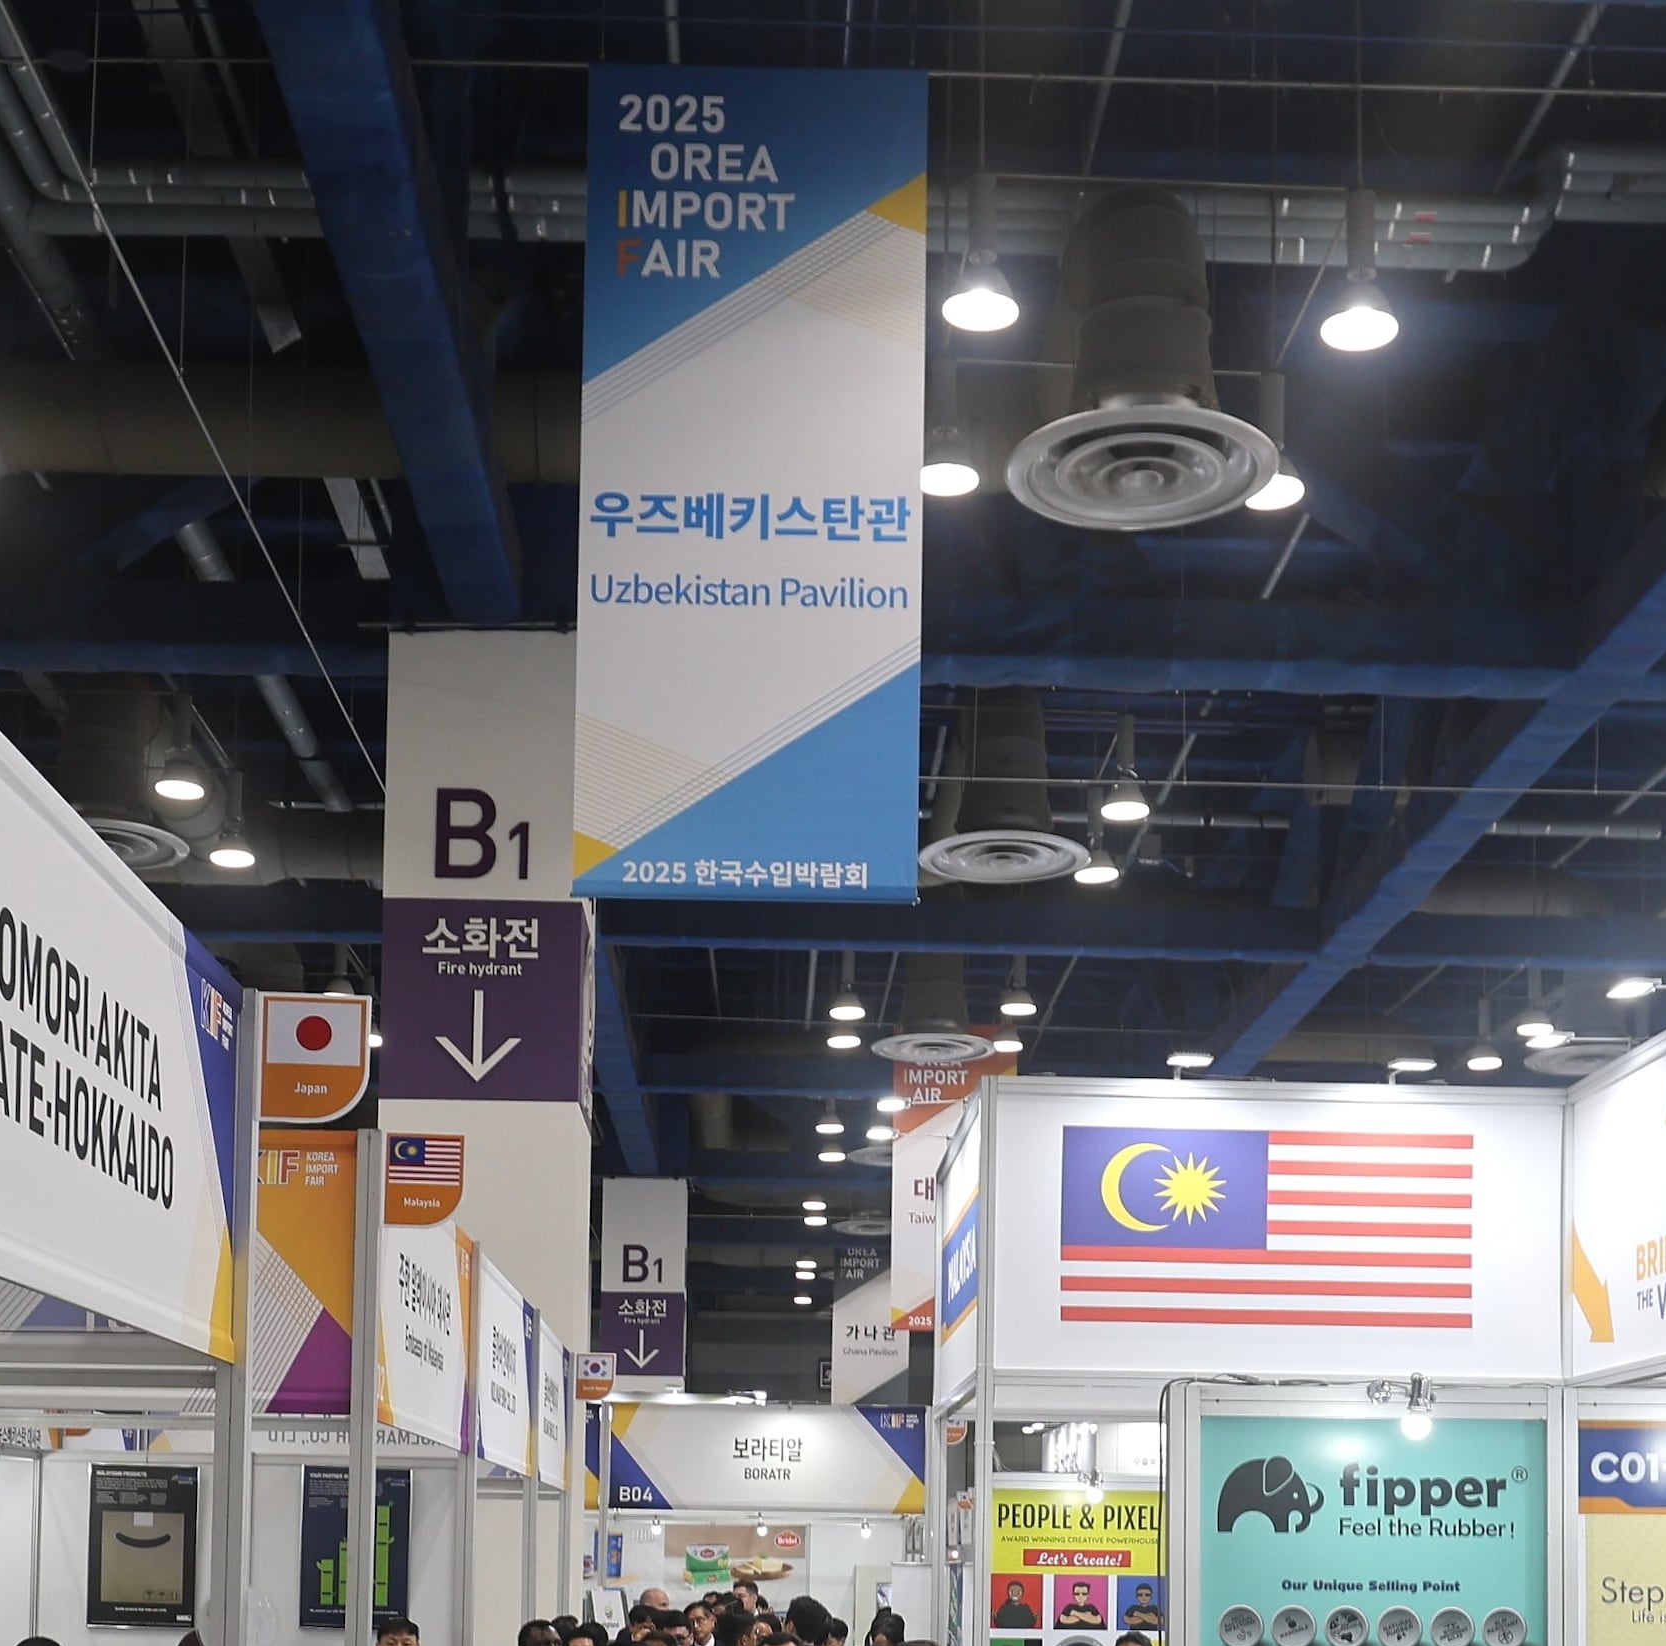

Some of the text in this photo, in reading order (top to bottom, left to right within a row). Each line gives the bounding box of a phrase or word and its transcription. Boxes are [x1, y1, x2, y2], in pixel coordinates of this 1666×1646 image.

[617, 94, 726, 134] 2025
[649, 142, 779, 185] OREA
[617, 189, 795, 233] IMPORT
[617, 238, 722, 280] FAIR
[589, 490, 911, 543] 우즈베키스탄관
[589, 571, 909, 611] Uzbekistan Pavilion
[434, 787, 530, 880] B1
[622, 858, 870, 891] 2025 한국수입박람회
[421, 917, 539, 959] 소화전
[438, 961, 523, 978] Fire hydrant
[294, 1082, 329, 1097] Japan
[306, 1152, 335, 1163] KOREA
[305, 1164, 339, 1175] IMPORT
[305, 1176, 325, 1187] FAIR
[403, 1196, 441, 1210] Malaysia
[622, 1244, 663, 1283] B1
[947, 1224, 977, 1304] MALAYSIA
[618, 1298, 667, 1319] 소화전
[1636, 1286, 1653, 1311] THE
[908, 1316, 933, 1327] 2025
[843, 1346, 899, 1357] Ghana Pavilion
[733, 1437, 804, 1463] 보라티알
[744, 1467, 791, 1481] BORATR
[619, 1486, 653, 1503] B04
[1339, 1462, 1507, 1515] fipper
[997, 1503, 1159, 1530] PEOPLE & PIXEL
[1339, 1518, 1384, 1538] Feel
[1388, 1518, 1423, 1538] the
[1001, 1535, 1030, 1543] AWARD
[1067, 1536, 1104, 1544] CREATIVE
[1036, 1552, 1123, 1567] Let's Create!
[1281, 1580, 1461, 1593] Our Unique Selling Point
[1601, 1576, 1665, 1612] Step
[1631, 1609, 1655, 1624] Life
